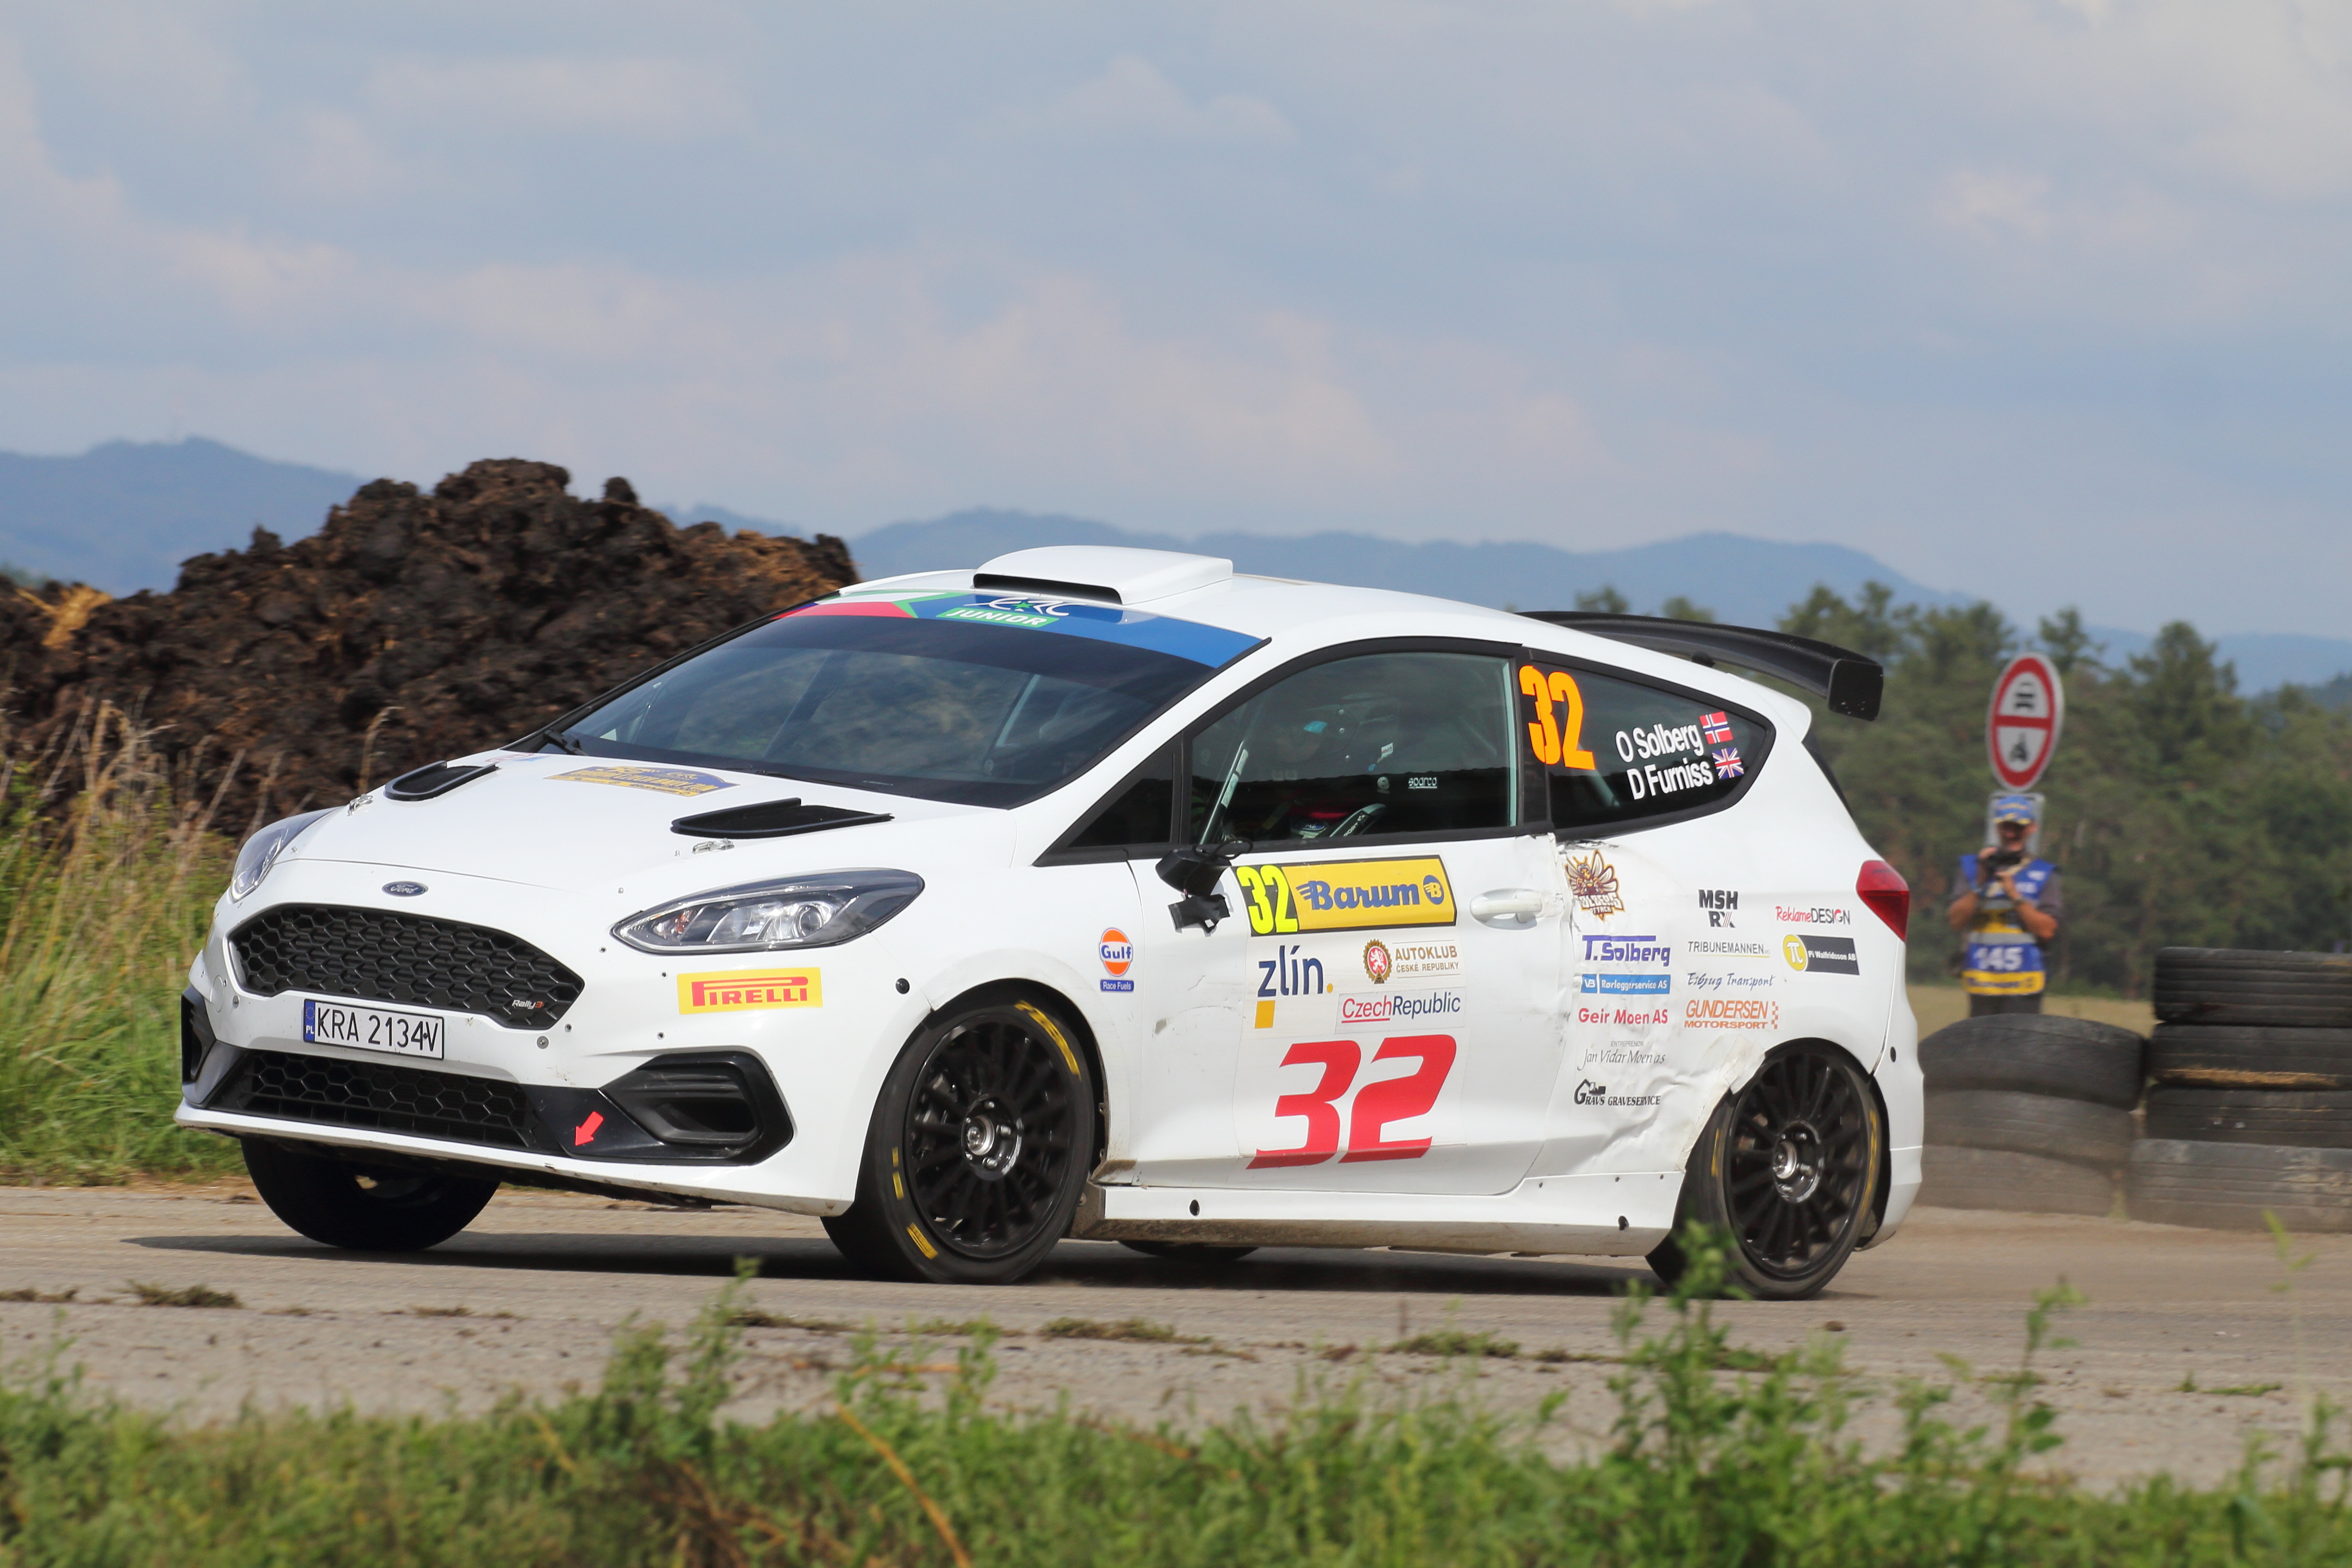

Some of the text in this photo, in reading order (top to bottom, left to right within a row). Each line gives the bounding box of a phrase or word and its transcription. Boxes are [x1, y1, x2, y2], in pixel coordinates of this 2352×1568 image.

[946, 609, 1047, 625] JUNIOR
[1520, 665, 1595, 770] 32
[1616, 723, 1704, 762] O Solberg
[1408, 777, 1437, 789] sparco
[1627, 758, 1713, 800] D Furniss
[390, 884, 418, 894] Ford
[1296, 881, 1419, 910] Barum
[1236, 865, 1298, 934] 32
[1698, 889, 1738, 910] MSH
[1708, 911, 1736, 928] RX
[1101, 945, 1131, 959] Gulf
[1395, 945, 1457, 961] AUTOKLUB
[1582, 935, 1671, 966] T.Solberg
[1973, 947, 2024, 970] 145
[1396, 962, 1459, 973] ČESKÉ REPUBLIKY
[1103, 981, 1131, 990] Race Fuels
[1584, 979, 1595, 988] VB
[1658, 980, 1667, 989] AS
[1727, 973, 1775, 991] Transport
[692, 976, 808, 1007] PIRELLI
[512, 999, 544, 1009] Rally3
[1686, 1000, 1768, 1019] GUNDERSEN
[1578, 1008, 1668, 1024] Geir Moen AS
[306, 1025, 314, 1034] PL
[318, 1007, 439, 1052] KRA 2134V
[1684, 1021, 1768, 1030] MOTORSPORT
[1577, 1049, 1597, 1071] Jan
[1600, 1049, 1627, 1063] Vidar
[1627, 1050, 1652, 1064] Moen
[1246, 1034, 1456, 1169] 32
[1608, 1095, 1661, 1106] GRAVESERVICE
